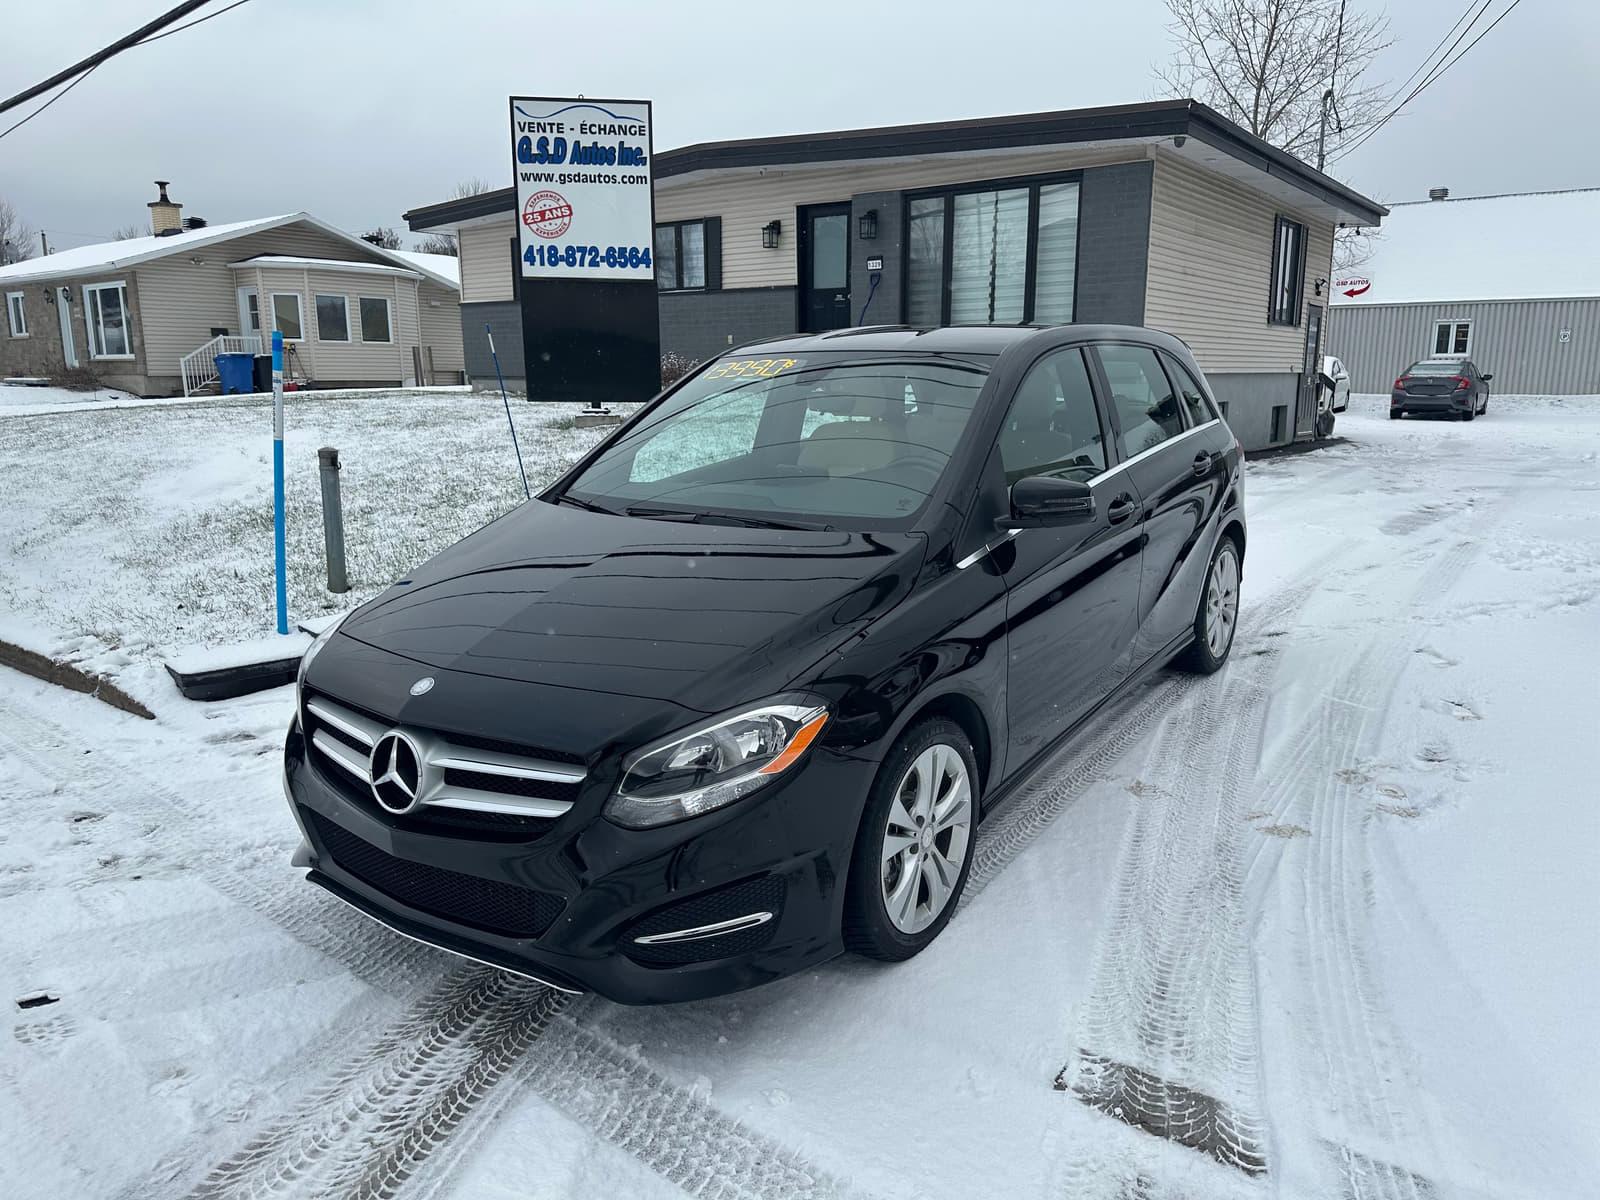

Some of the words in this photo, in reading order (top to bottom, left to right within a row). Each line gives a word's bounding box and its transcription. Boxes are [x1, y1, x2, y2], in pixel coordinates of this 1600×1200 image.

[517, 121, 565, 134] VENTE
[579, 120, 646, 136] ÉCHANGE
[569, 140, 617, 165] Autos
[617, 140, 648, 166] Inc.
[520, 172, 648, 185] www.gsdautos.com
[525, 214, 541, 224] 25
[545, 206, 571, 219] ANS
[523, 245, 652, 269] 418-872-6564
